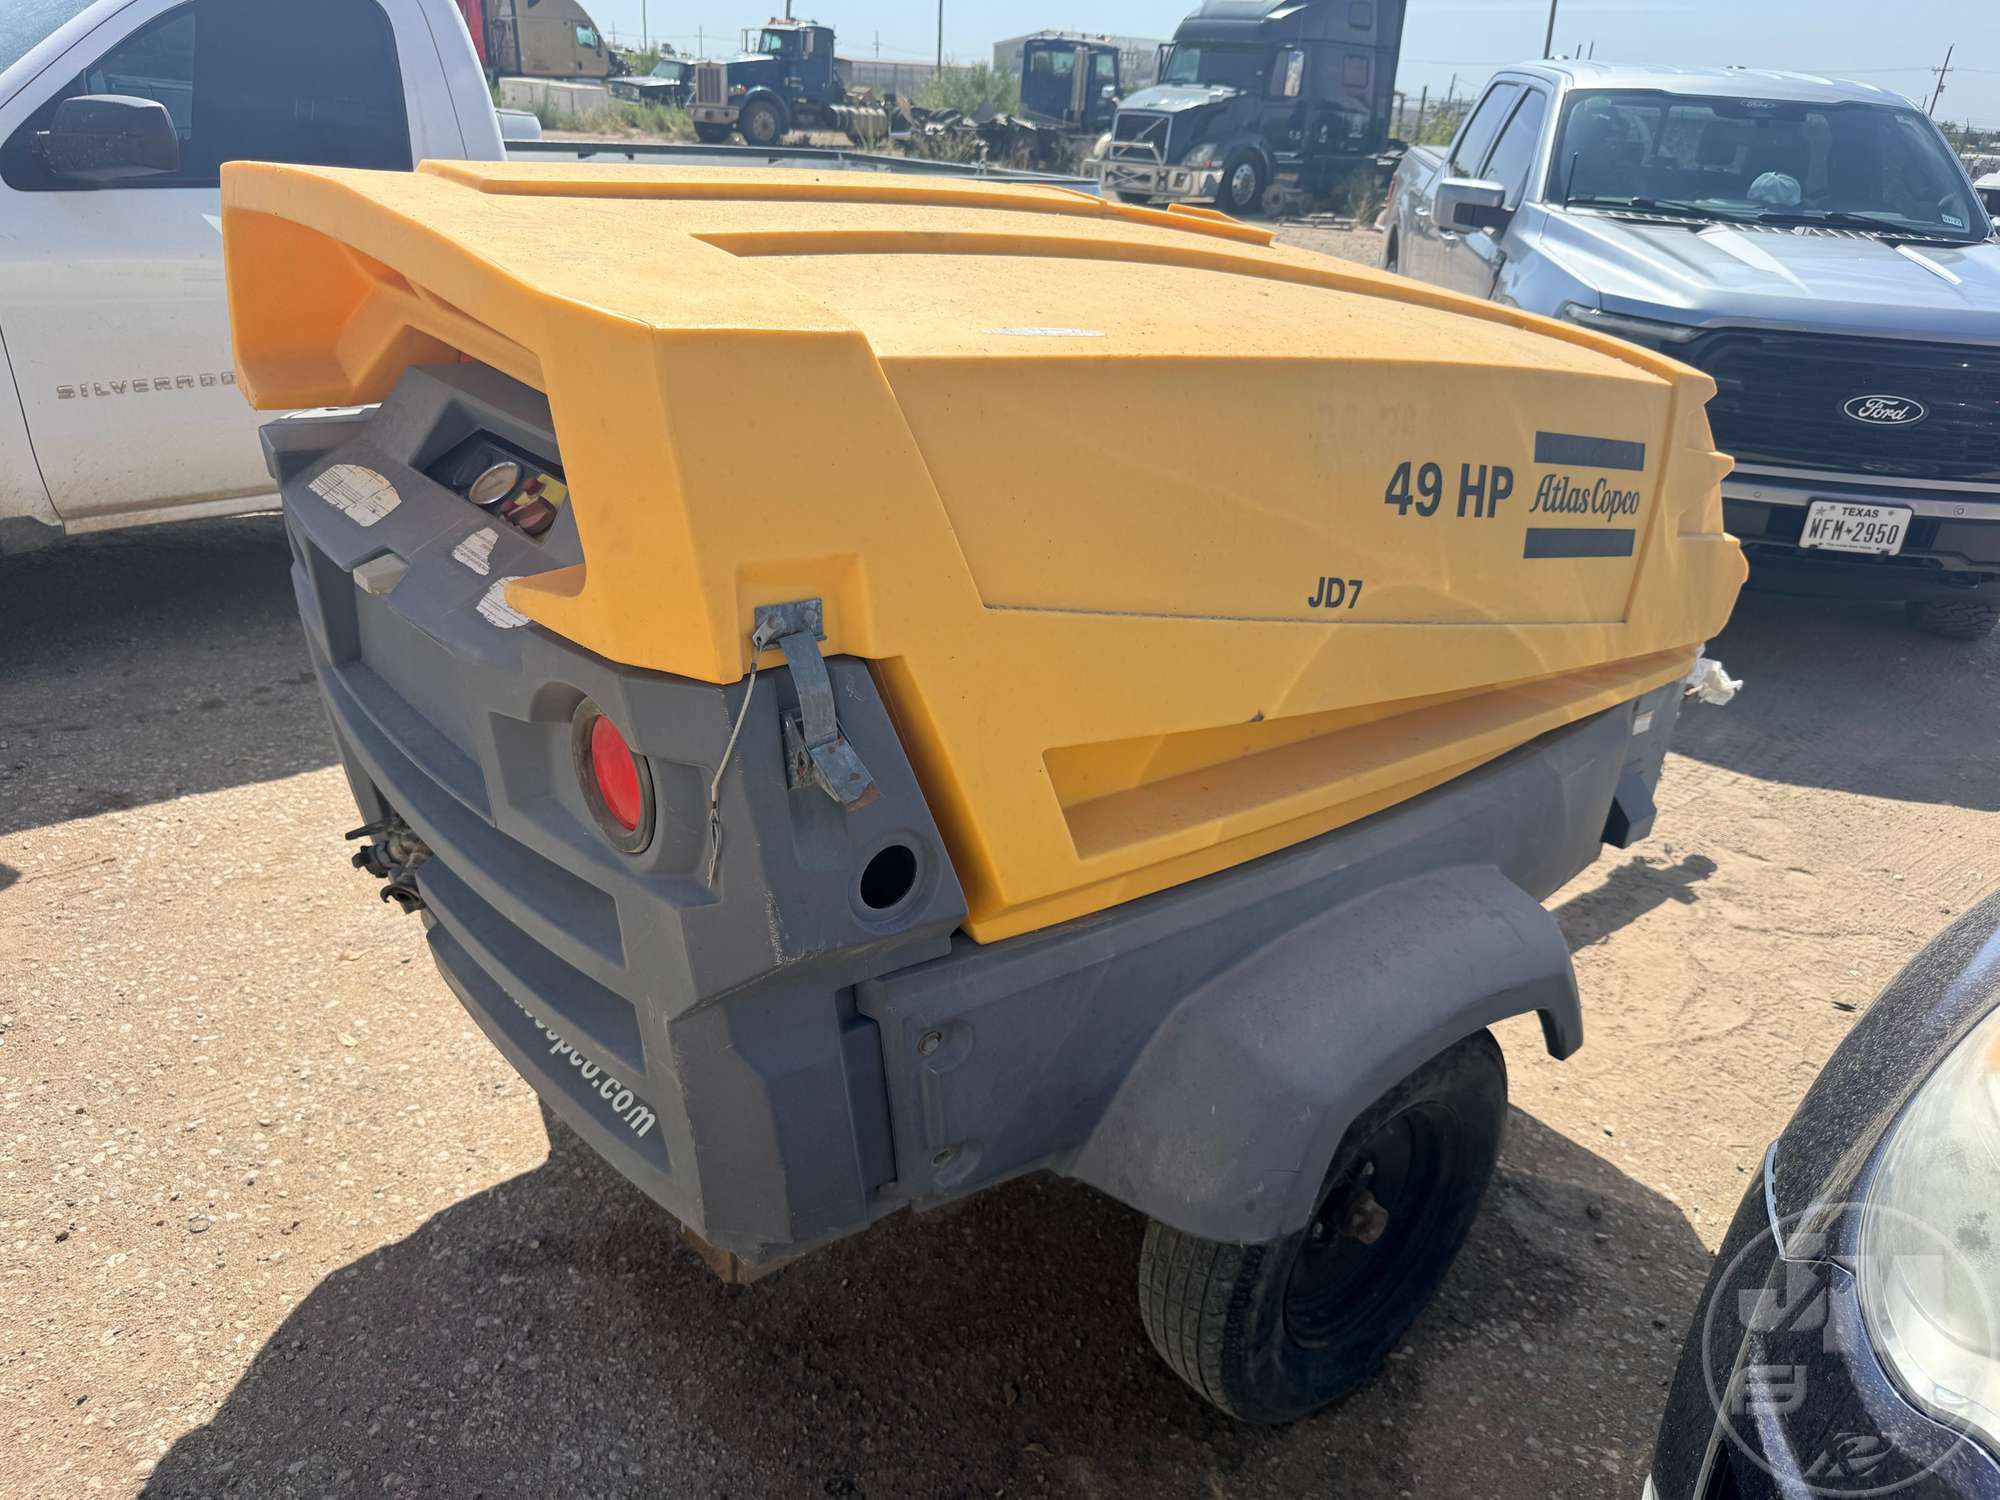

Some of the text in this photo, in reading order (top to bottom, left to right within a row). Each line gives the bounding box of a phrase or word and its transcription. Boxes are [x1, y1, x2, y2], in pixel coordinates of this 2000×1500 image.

[56, 371, 237, 400] SILVERADO
[1858, 398, 1910, 421] Ford
[1384, 461, 1514, 518] 49 HP
[1842, 507, 1880, 519] TEXAS
[1308, 576, 1363, 609] JD7
